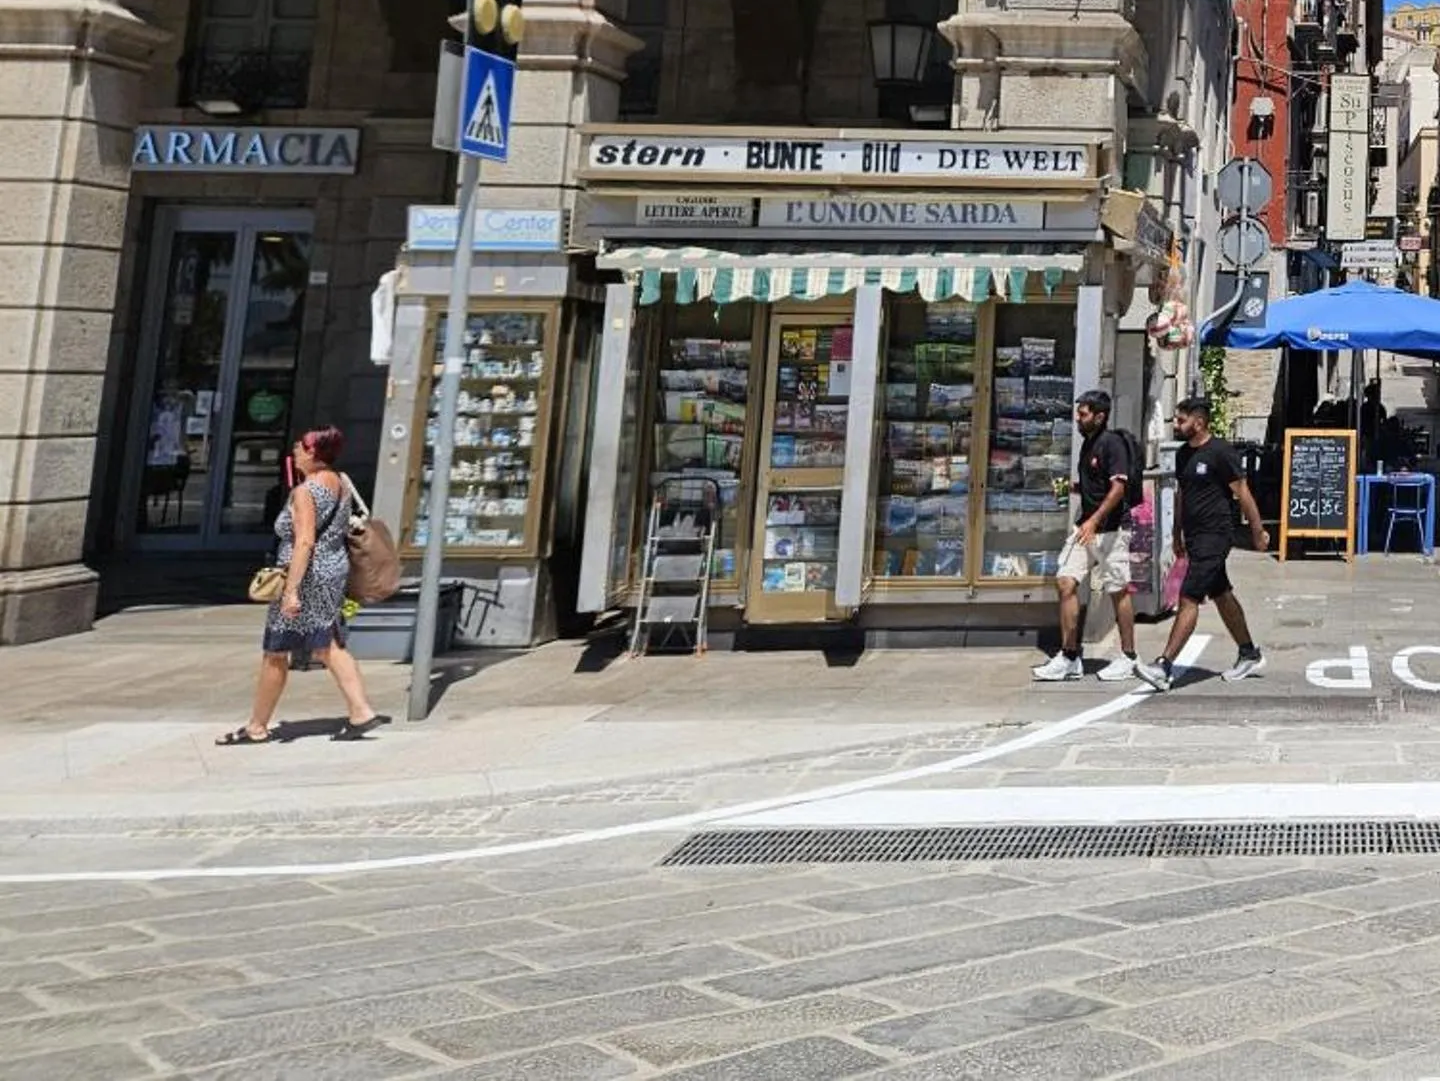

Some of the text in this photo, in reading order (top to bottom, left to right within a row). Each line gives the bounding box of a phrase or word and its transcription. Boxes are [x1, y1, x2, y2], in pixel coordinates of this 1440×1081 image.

[134, 131, 353, 166] ARMACIA
[596, 139, 1084, 174] stern BUNTE Bild DIE WELT
[484, 210, 556, 230] Center
[645, 205, 745, 219] LETTERE APERTE
[924, 203, 1017, 224] SARDA
